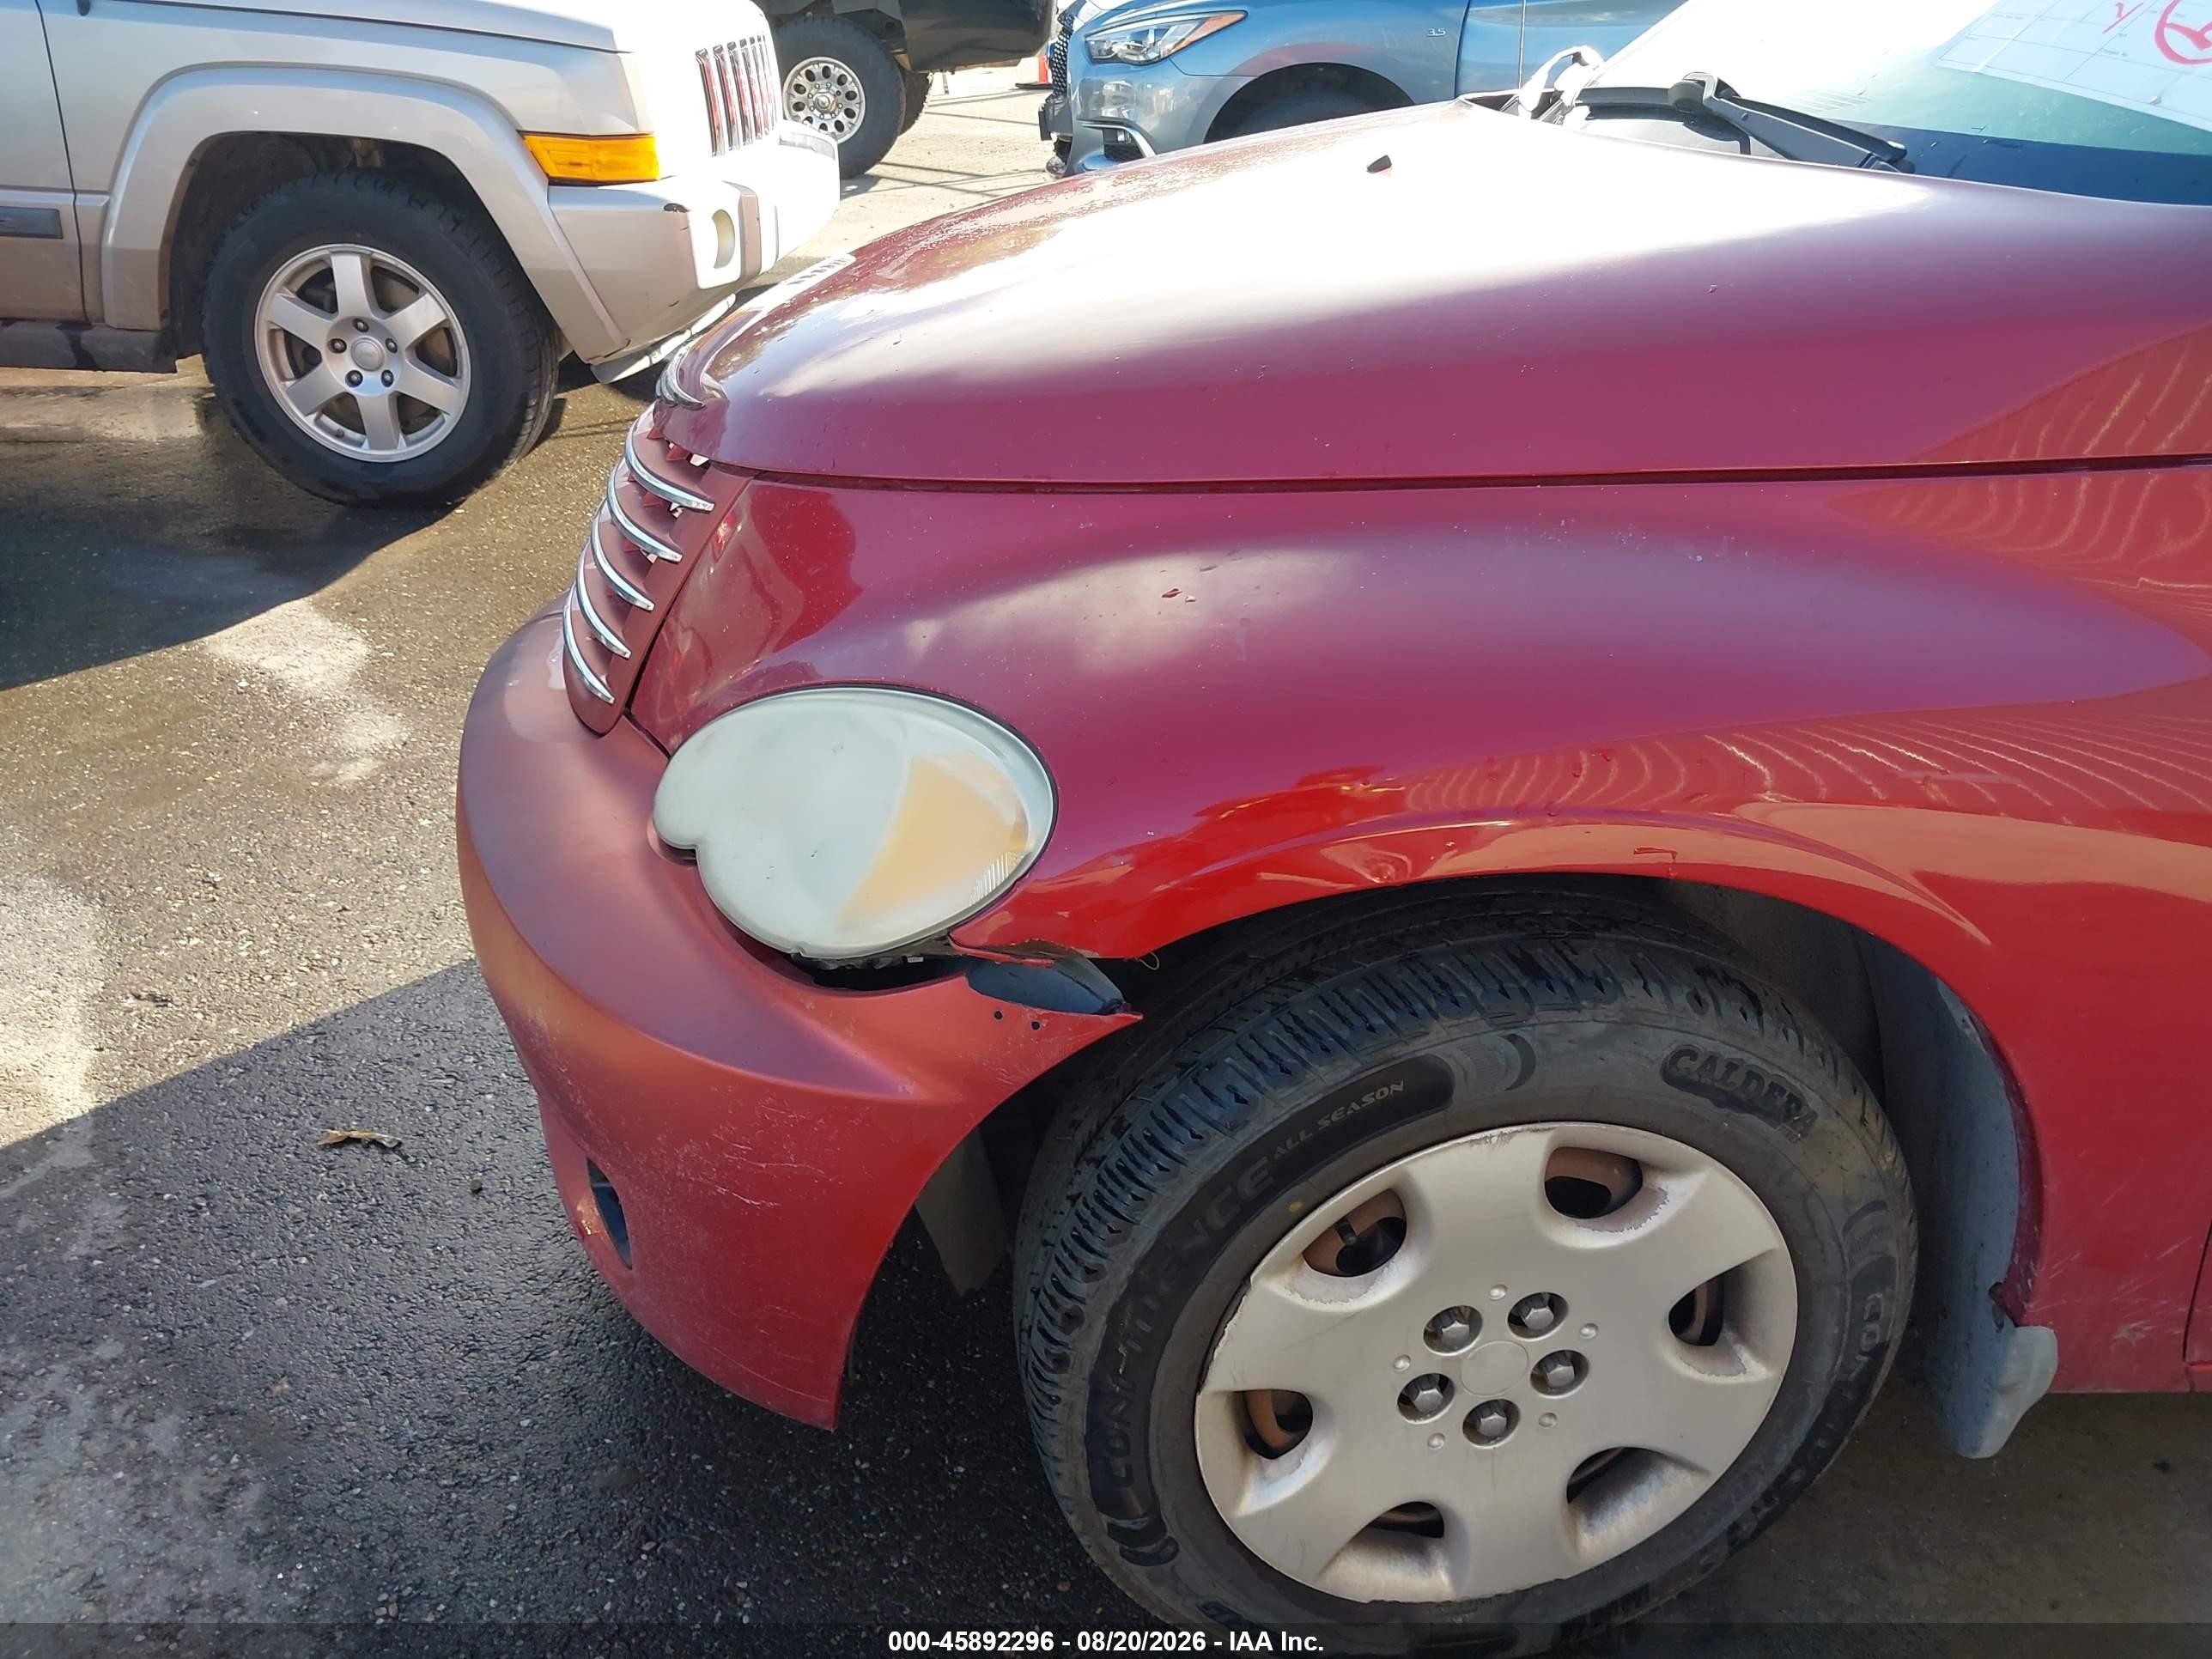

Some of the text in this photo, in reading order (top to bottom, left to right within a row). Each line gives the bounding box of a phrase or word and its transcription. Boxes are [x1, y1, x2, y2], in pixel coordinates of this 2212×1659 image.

[1426, 27, 1447, 37] 3.5
[1273, 1129, 1313, 1159] ALL
[1317, 1080, 1405, 1131] SEASON
